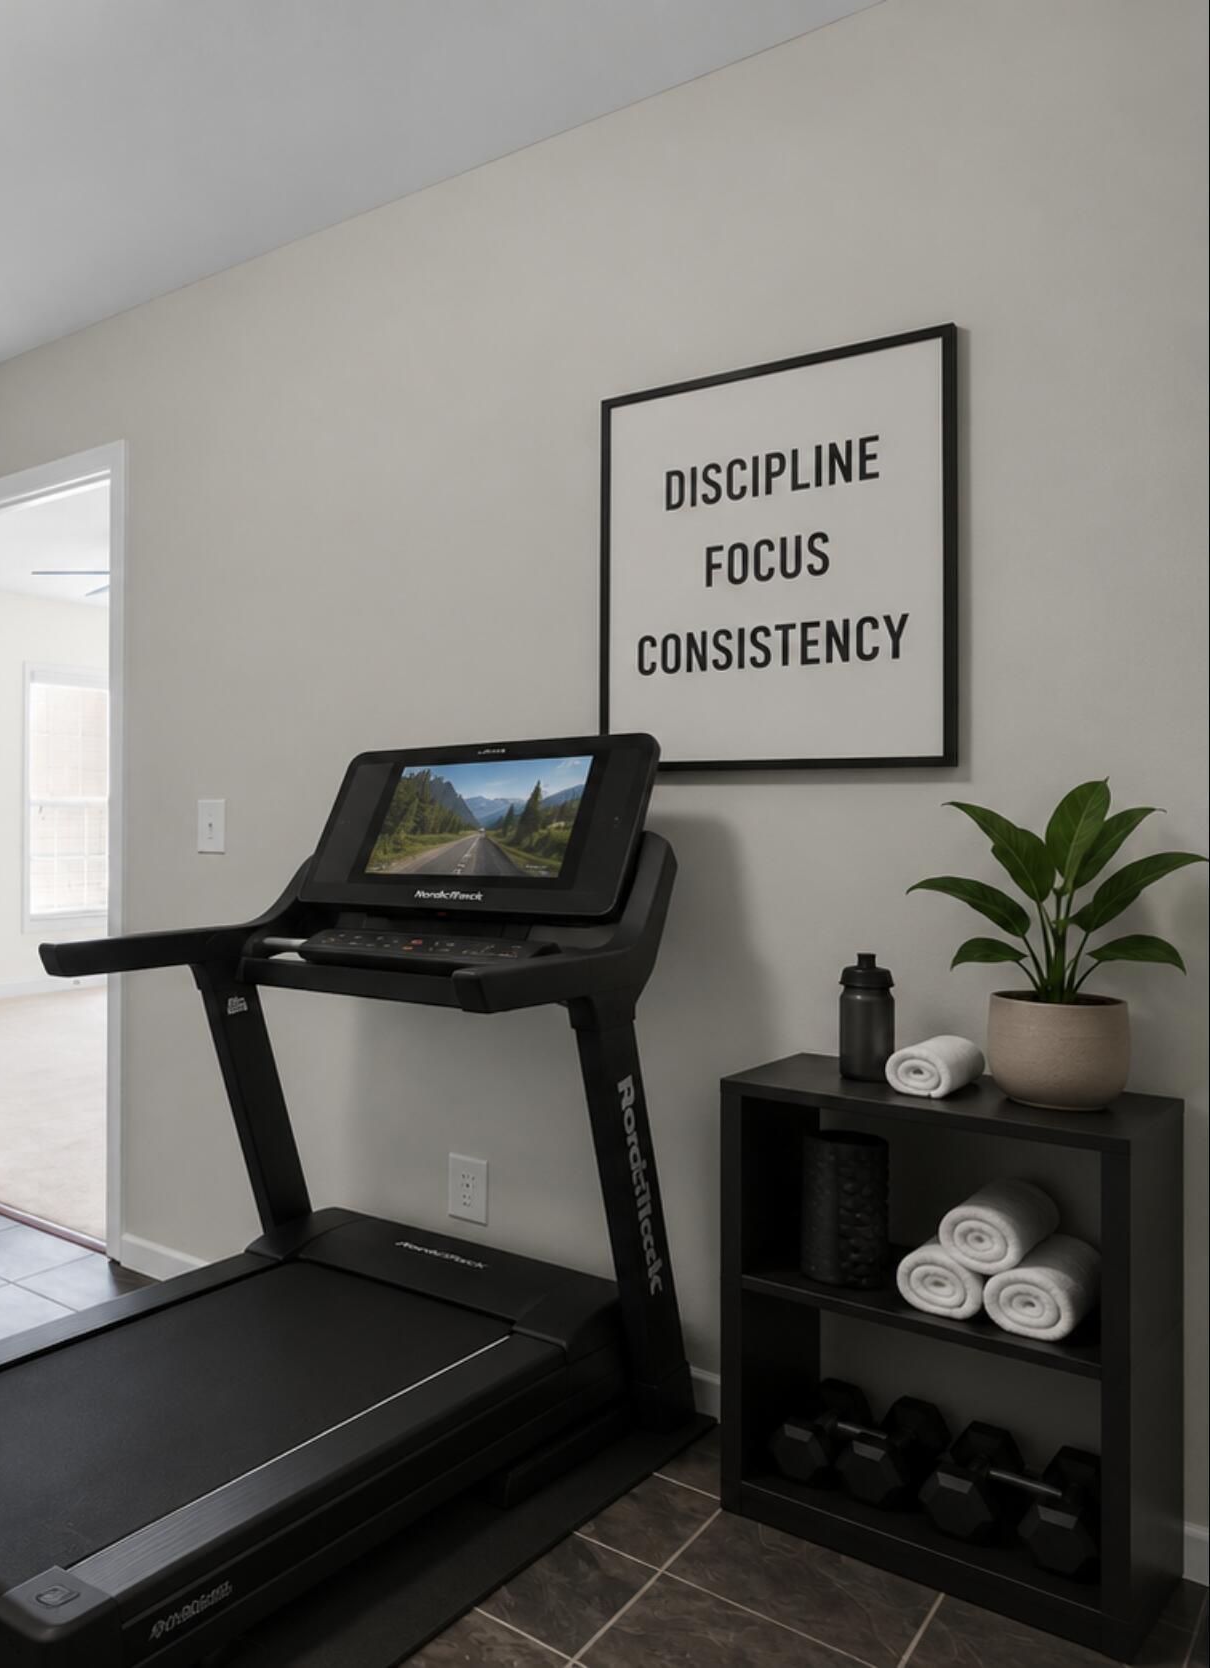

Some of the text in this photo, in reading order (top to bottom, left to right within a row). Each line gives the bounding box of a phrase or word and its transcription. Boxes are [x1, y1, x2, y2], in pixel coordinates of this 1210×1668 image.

[665, 434, 880, 511] DISCIPLINE
[705, 531, 830, 588] FOCUS
[637, 613, 910, 676] CONSISTENCY
